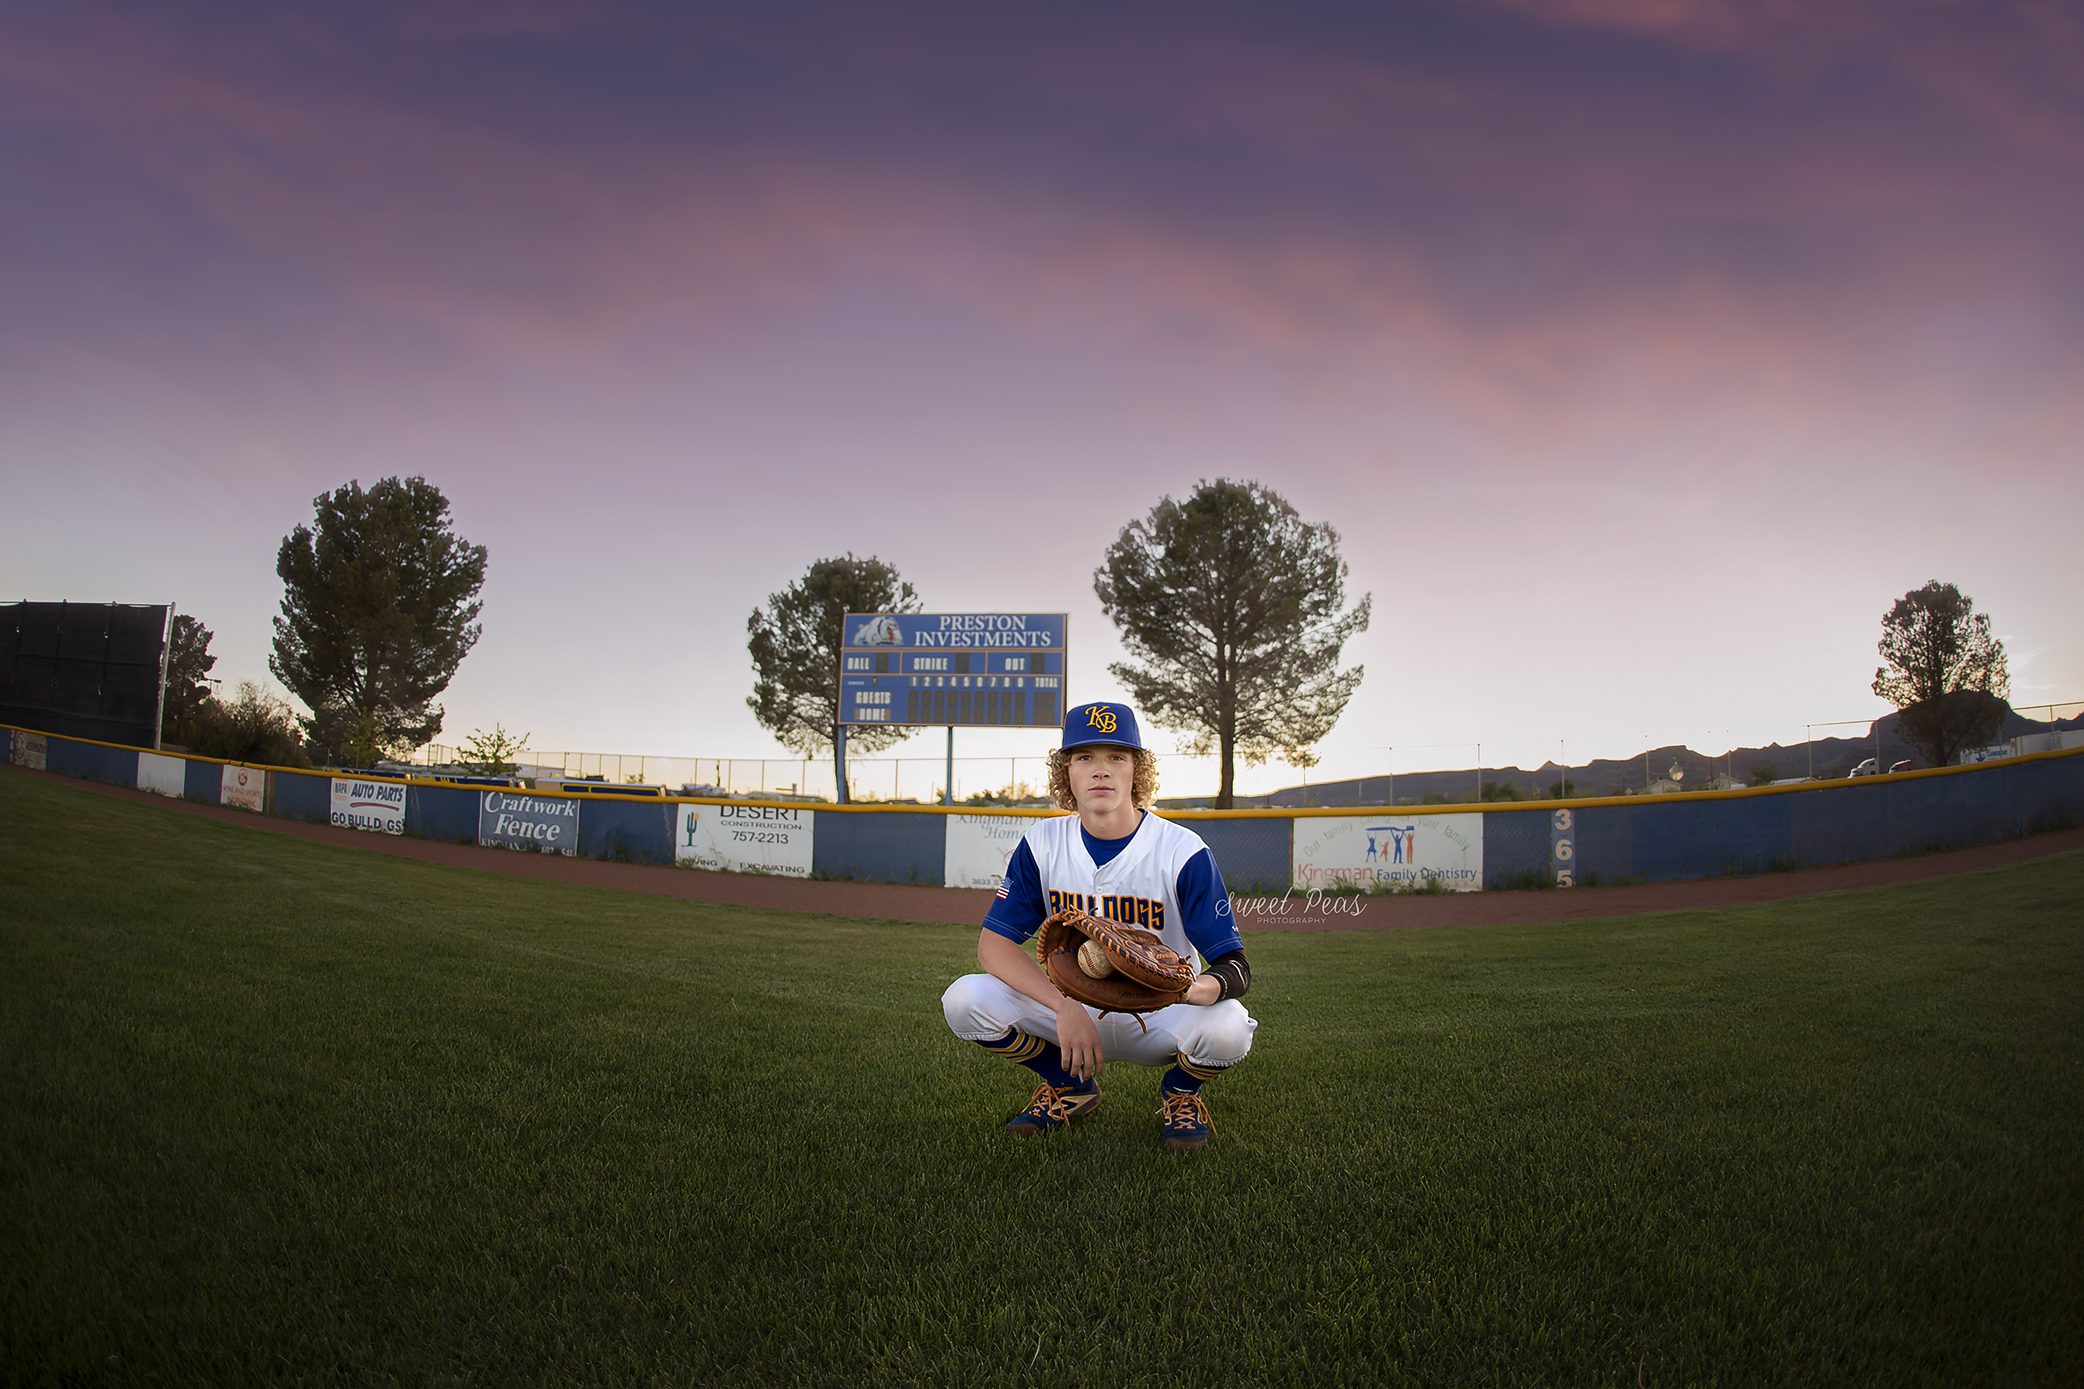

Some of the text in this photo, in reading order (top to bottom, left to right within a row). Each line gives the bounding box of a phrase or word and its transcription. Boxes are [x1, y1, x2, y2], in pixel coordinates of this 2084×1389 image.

[940, 615, 1026, 631] PRESTON
[914, 631, 1051, 647] INVESTMENTS
[847, 657, 870, 671] BALL
[913, 657, 948, 671] STRIKE
[1005, 658, 1025, 671] OUT
[1035, 677, 1059, 688] TOTAL
[855, 691, 891, 704] GUESTS
[859, 708, 886, 721] HOME
[335, 782, 348, 794] NAPA
[350, 783, 404, 803] AUTO PARTS
[484, 791, 576, 817] Craftwork
[332, 811, 347, 825] GO
[720, 805, 798, 821] DESERT
[493, 813, 561, 841] Fence
[721, 819, 803, 831] CONSTRUCTION
[731, 830, 790, 845] 757-2213
[1303, 841, 1322, 857] Our
[1323, 820, 1354, 842] family
[1443, 824, 1471, 851] family
[740, 861, 806, 874] EXCAVATING
[1297, 863, 1477, 884] Kingman Family Dentistry
